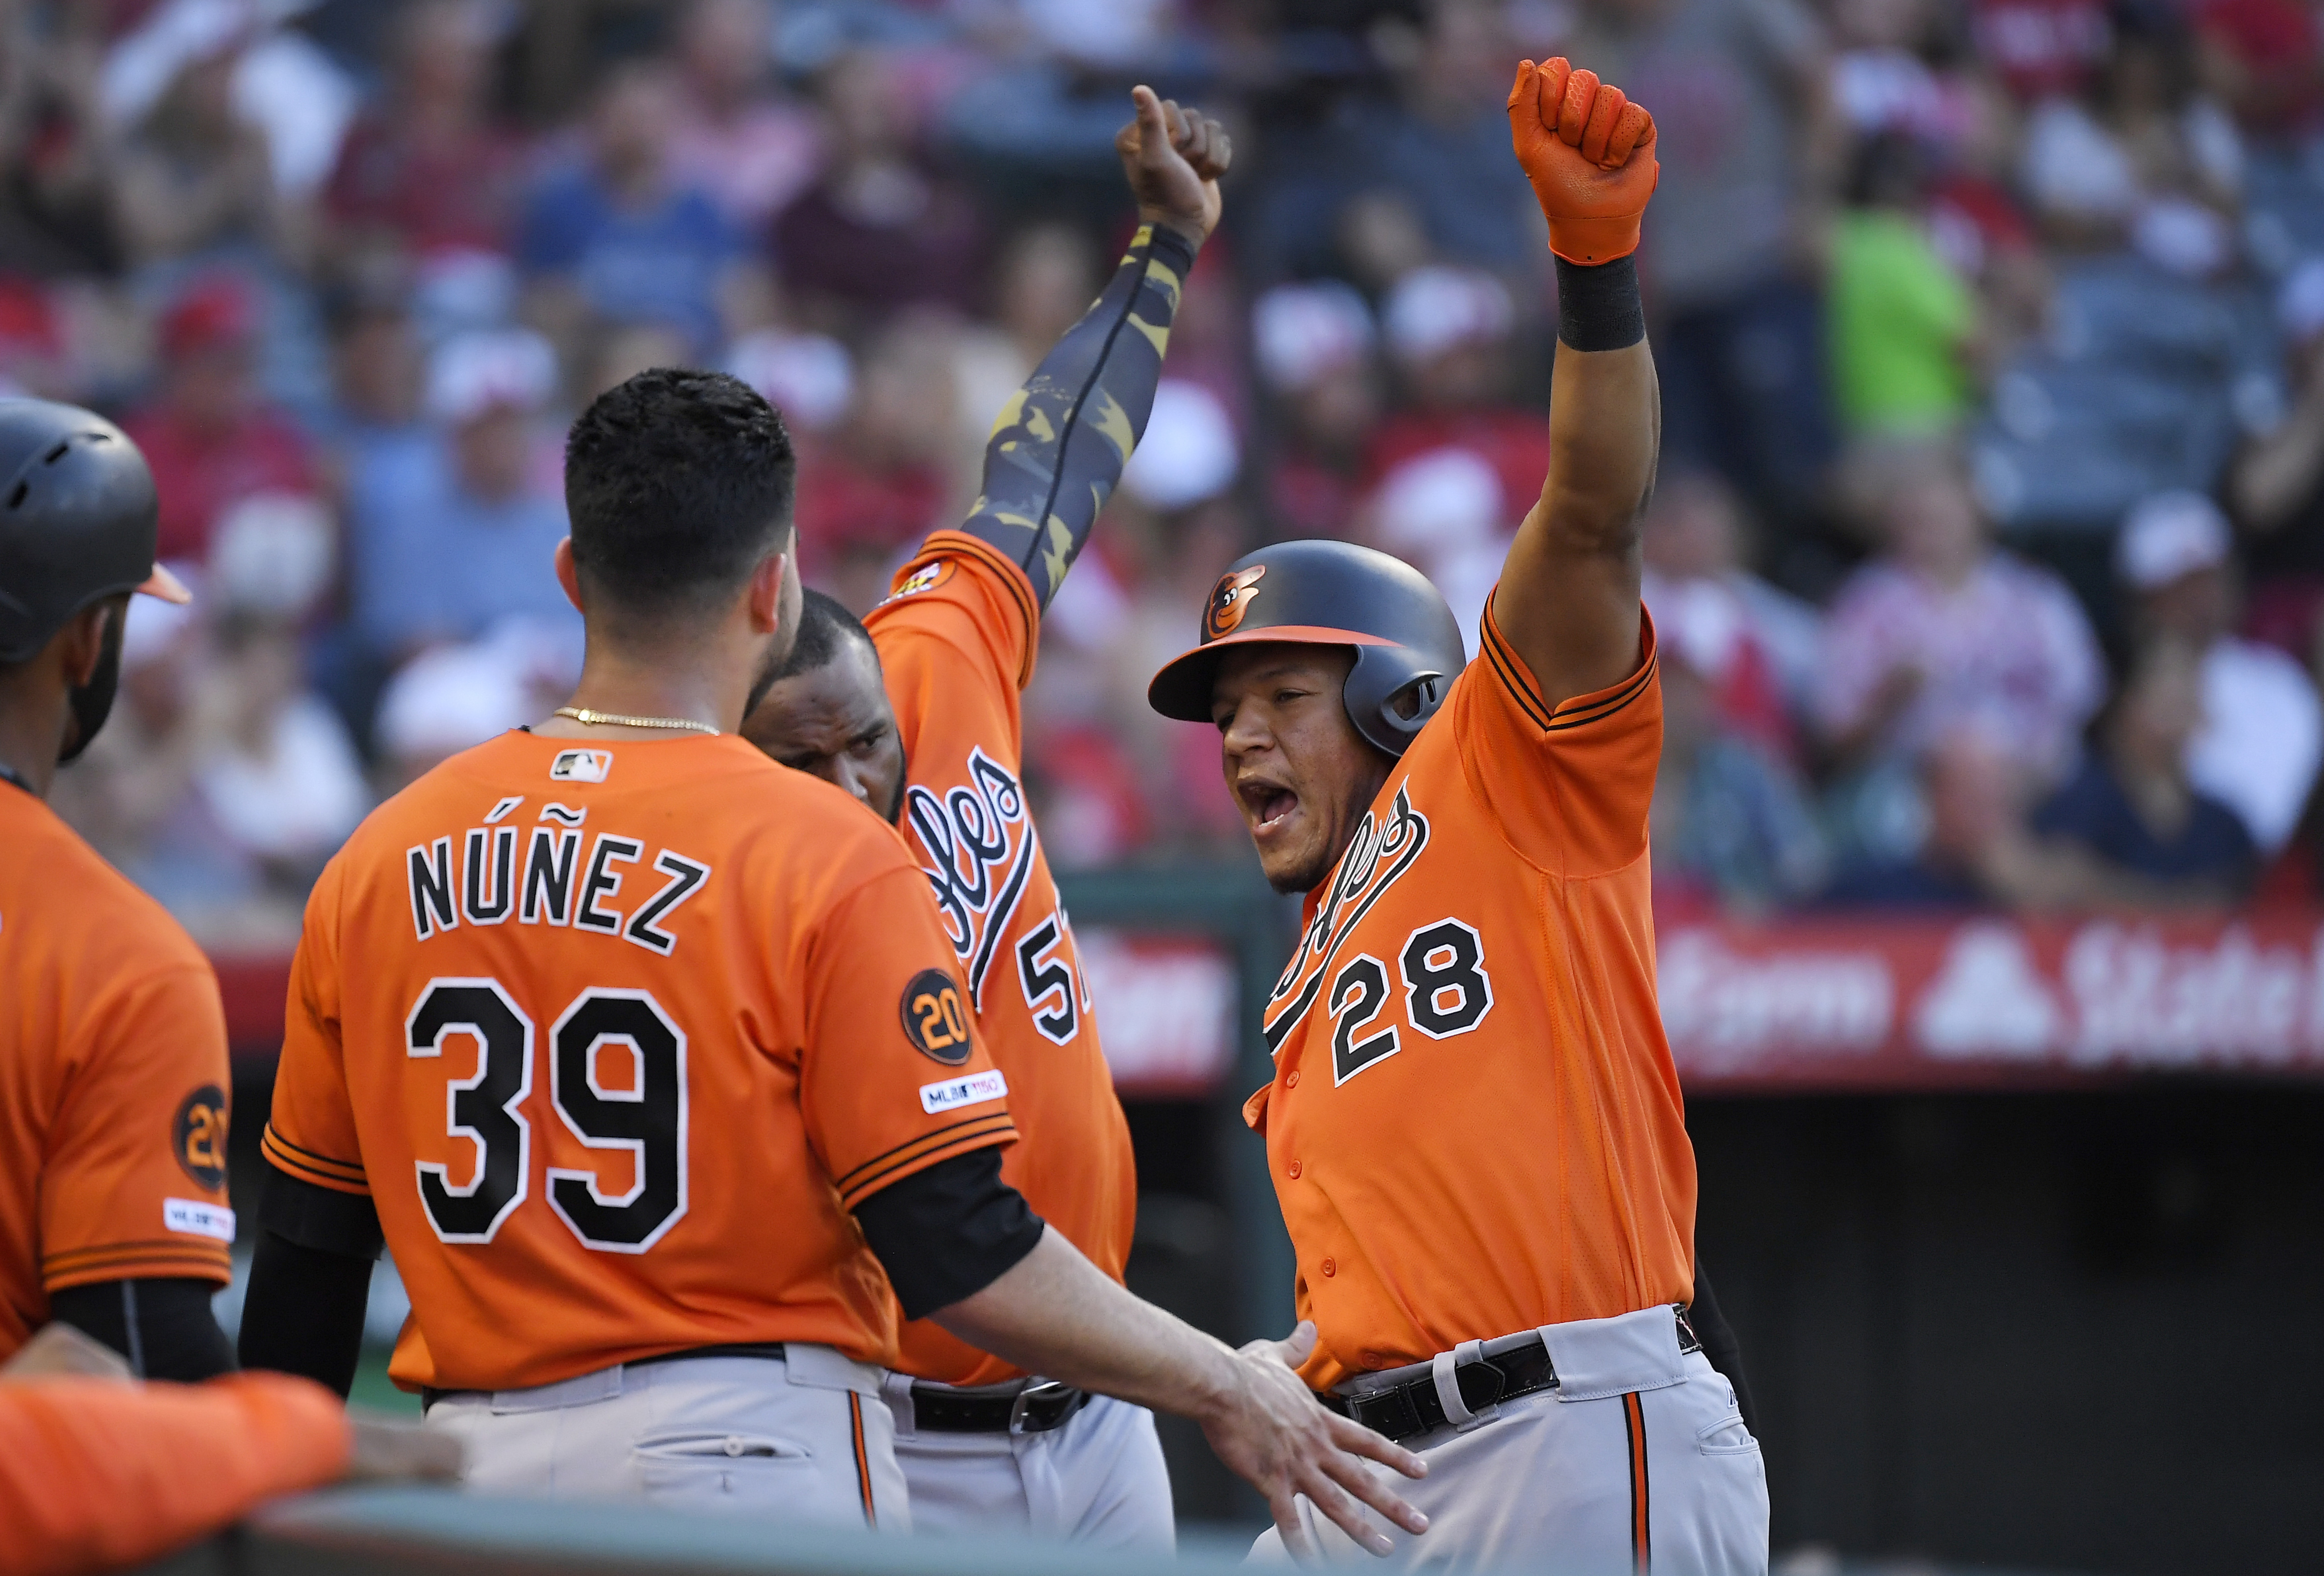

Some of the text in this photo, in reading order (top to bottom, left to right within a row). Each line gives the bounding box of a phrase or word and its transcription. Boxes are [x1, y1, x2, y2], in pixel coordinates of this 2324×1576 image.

[406, 795, 711, 957] NÚÑEZ
[912, 987, 967, 1051] 20
[1015, 882, 1092, 1047] 5
[1328, 916, 1495, 1088] 28
[404, 977, 688, 1254] 39
